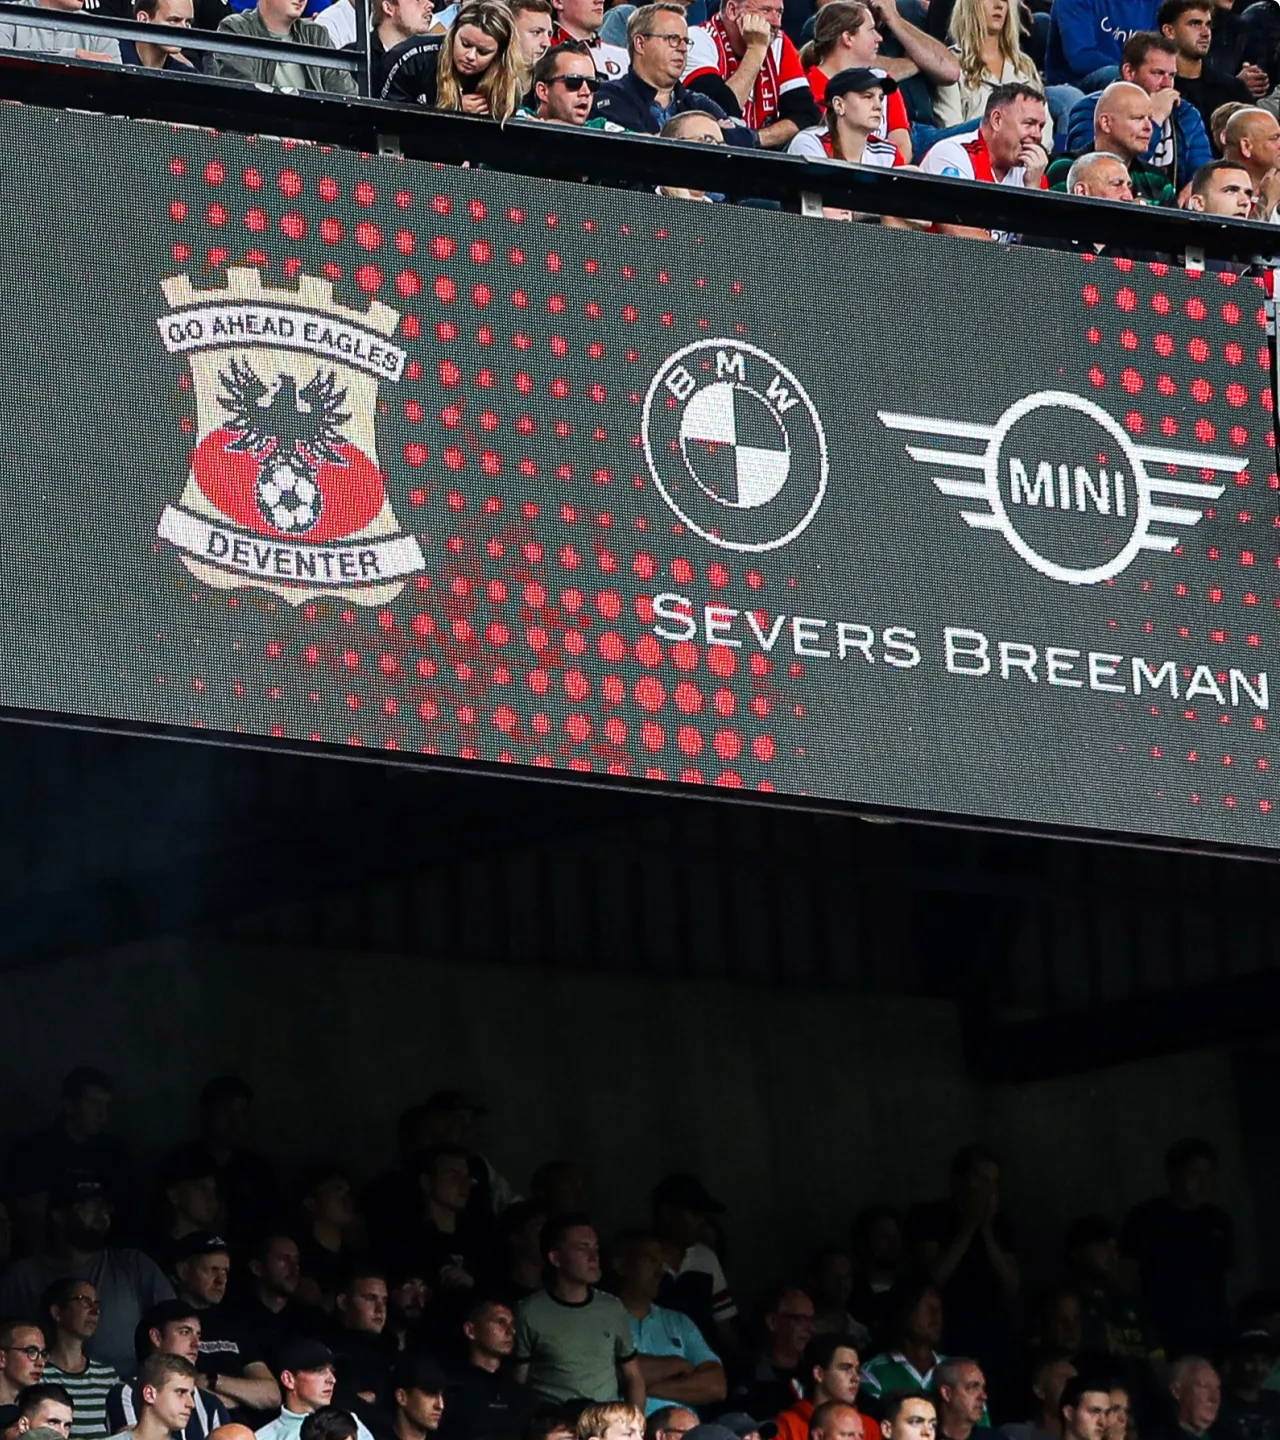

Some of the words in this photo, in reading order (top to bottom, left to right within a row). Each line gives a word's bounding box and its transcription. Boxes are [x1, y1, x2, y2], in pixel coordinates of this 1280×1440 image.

[168, 321, 204, 344] GO
[212, 314, 295, 339] AHEAD
[303, 322, 400, 373] EAGLES
[666, 350, 800, 413] BMW
[1008, 457, 1128, 518] MINI
[206, 531, 381, 578] DEVENTER
[651, 592, 922, 669] SEVERS
[943, 626, 1270, 712] BREEMAN
